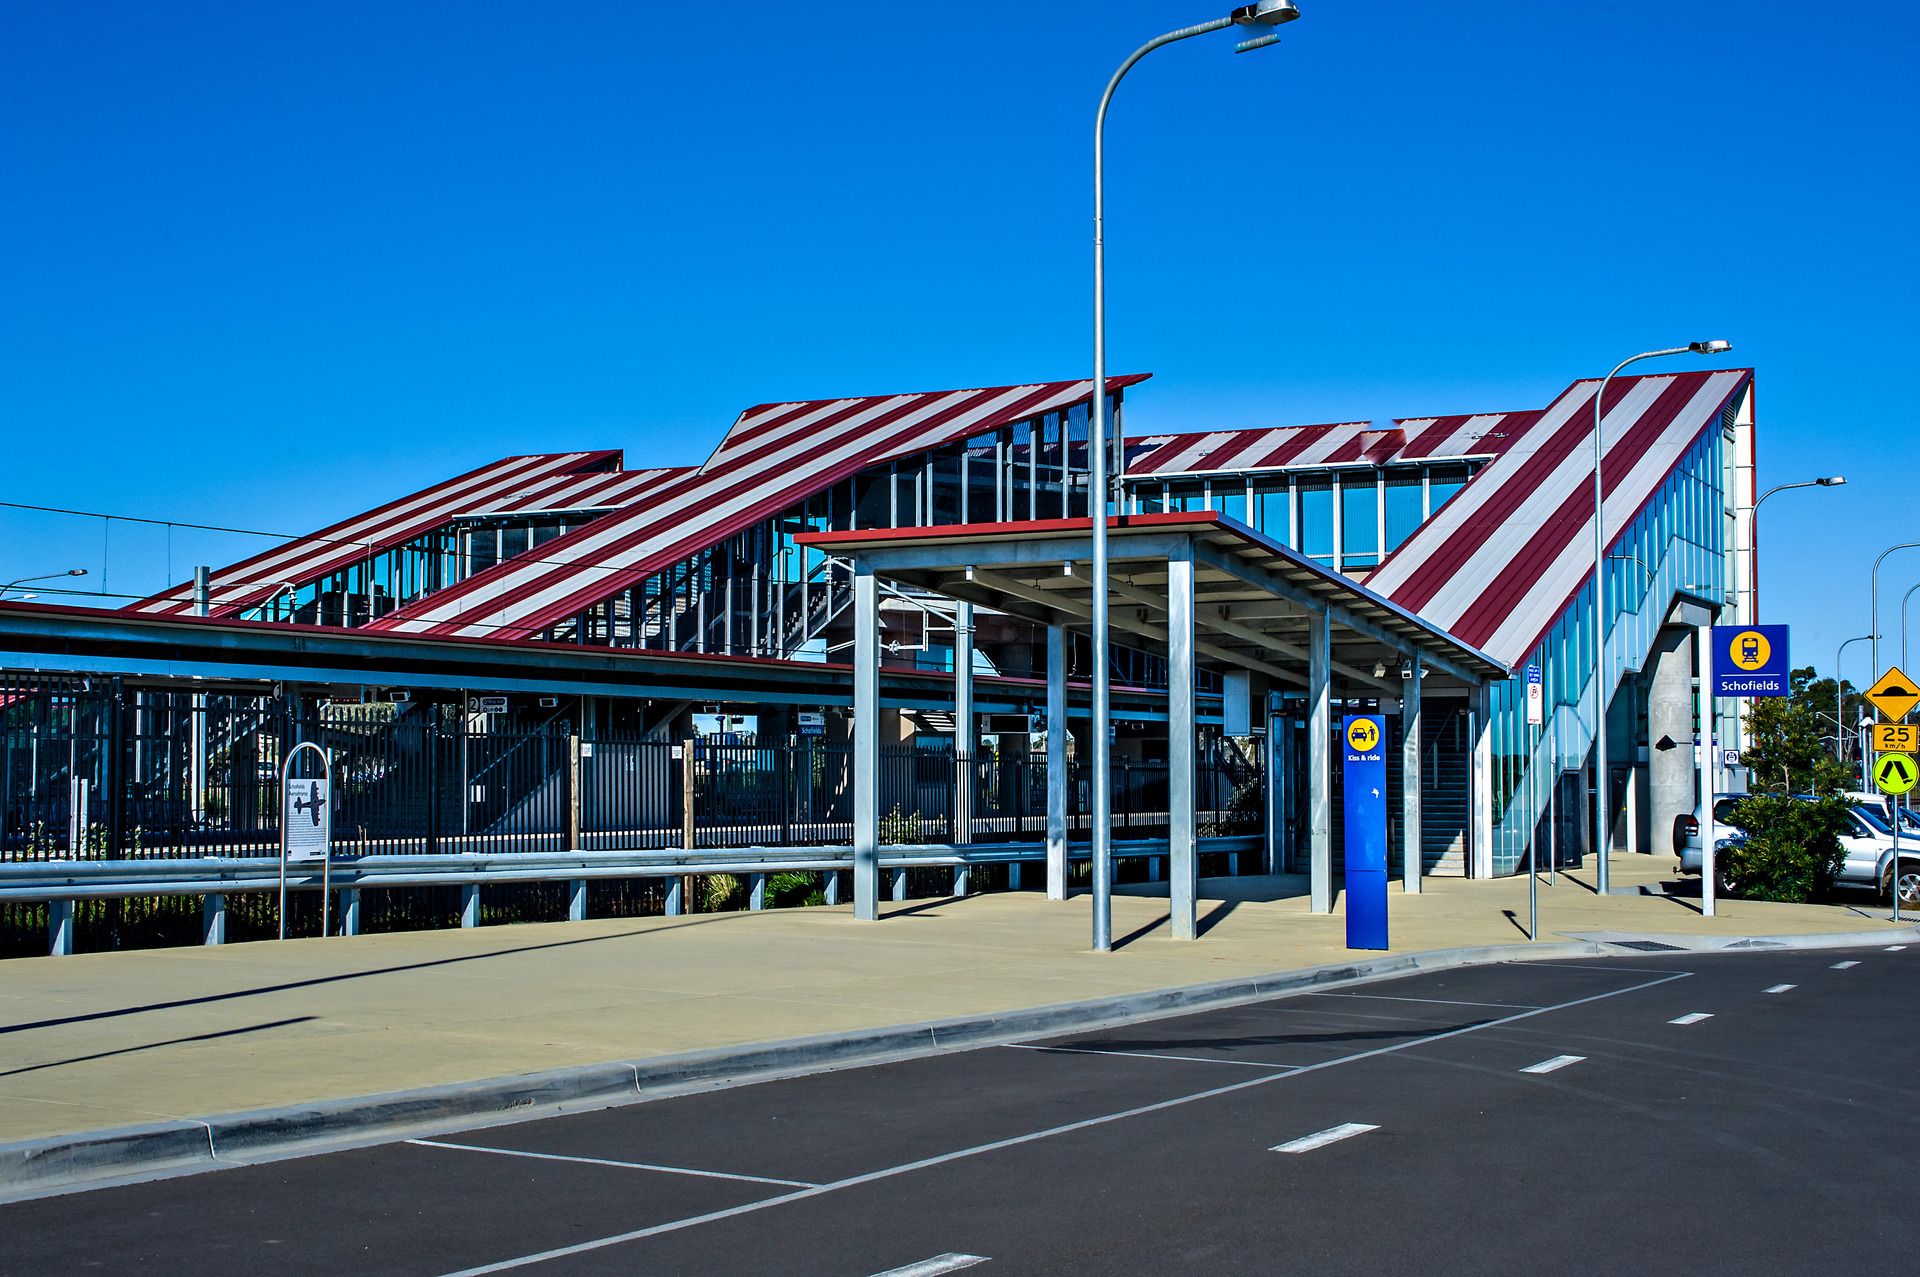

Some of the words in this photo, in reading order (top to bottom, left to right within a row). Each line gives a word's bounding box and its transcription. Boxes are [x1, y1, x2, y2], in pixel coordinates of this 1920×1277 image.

[1721, 680, 1780, 691] Schofields
[470, 699, 477, 710] 2
[1883, 727, 1910, 742] 25
